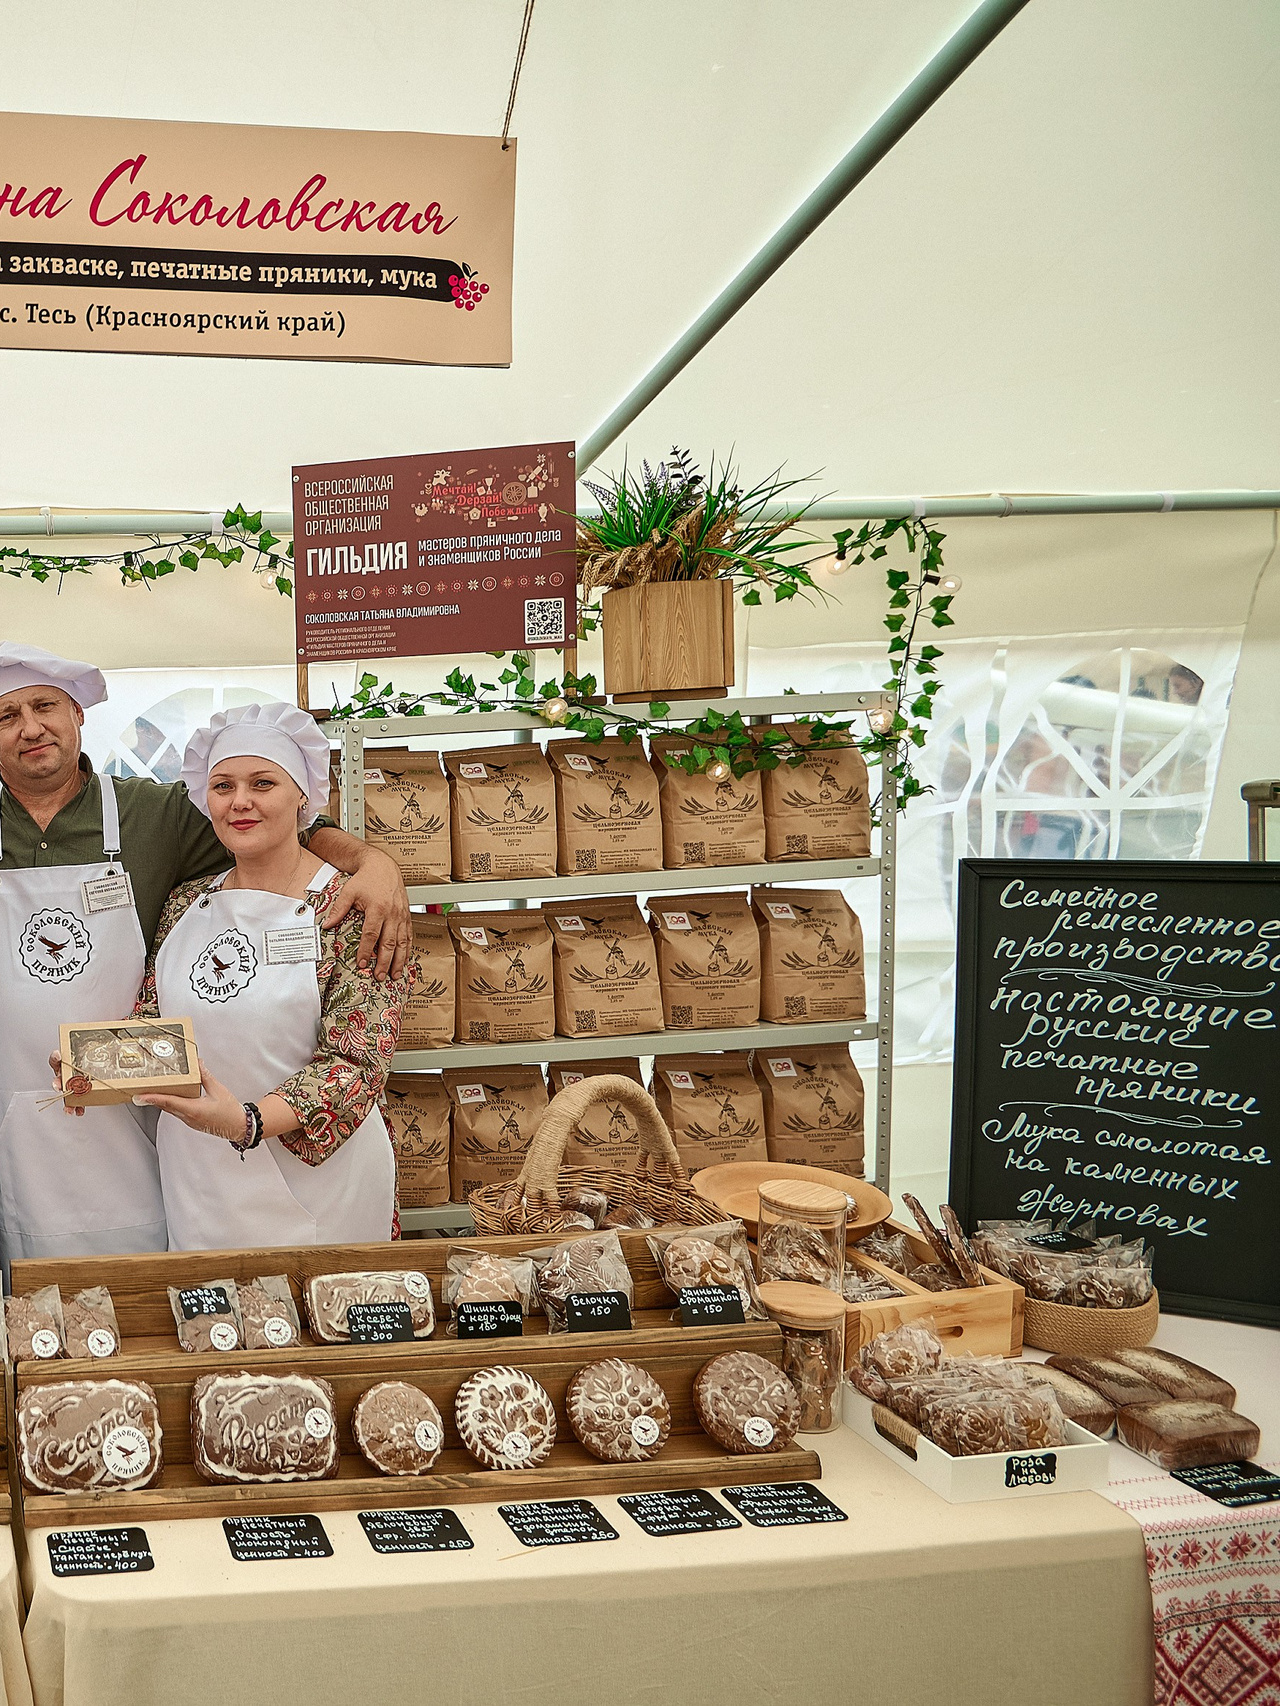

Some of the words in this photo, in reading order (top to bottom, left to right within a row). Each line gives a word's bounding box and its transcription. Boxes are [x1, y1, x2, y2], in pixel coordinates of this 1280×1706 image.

[89, 154, 458, 235] Соколовская
[9, 255, 123, 280] закваске,
[130, 260, 252, 282] печатные
[258, 264, 374, 290] пряники,
[380, 269, 438, 291] мука
[0, 308, 18, 324] с.
[26, 304, 75, 325] Тесь
[86, 305, 270, 333] (Красноярский
[277, 310, 346, 337] край)
[305, 475, 393, 498] ВСЕРОССИЙСКАЯ
[305, 495, 389, 517] ОБЩЕСТВЕННАЯ
[481, 504, 537, 518] Побеждай!
[305, 515, 381, 536] ОРГАНИЗАЦИЯ
[418, 534, 467, 552] мастеров
[470, 532, 532, 548] пряничного
[535, 530, 561, 544] дела
[419, 556, 425, 566] и
[427, 551, 500, 566] знаменщиков
[503, 546, 541, 560] России
[307, 541, 407, 576] ГИЛЬДИЯ
[306, 611, 358, 624] СОКОЛОВСКАЯ
[360, 609, 395, 621] ТАТЬЯНА
[396, 604, 460, 618] ВЛАДИМИРОВНА
[1000, 879, 1158, 910] Семейное
[27, 915, 86, 952] СОКОЛОВСКИЙ
[1041, 910, 1280, 942] ремесленное
[31, 957, 81, 977] ПРЯНИК
[199, 936, 250, 973] СОКОЛОВСКИЙ
[197, 977, 238, 996] ПРЯНИК
[1001, 1013, 1210, 1049] русские
[1002, 1049, 1198, 1079] печатные
[1075, 1074, 1260, 1115] пряники
[982, 1113, 1084, 1154] Мука
[1095, 1130, 1271, 1164] смолотая
[1005, 1149, 1049, 1171] на
[1065, 1158, 1239, 1200] каменных
[571, 1296, 619, 1306] Белочка
[590, 1305, 611, 1316] 150
[704, 1304, 722, 1313] 150
